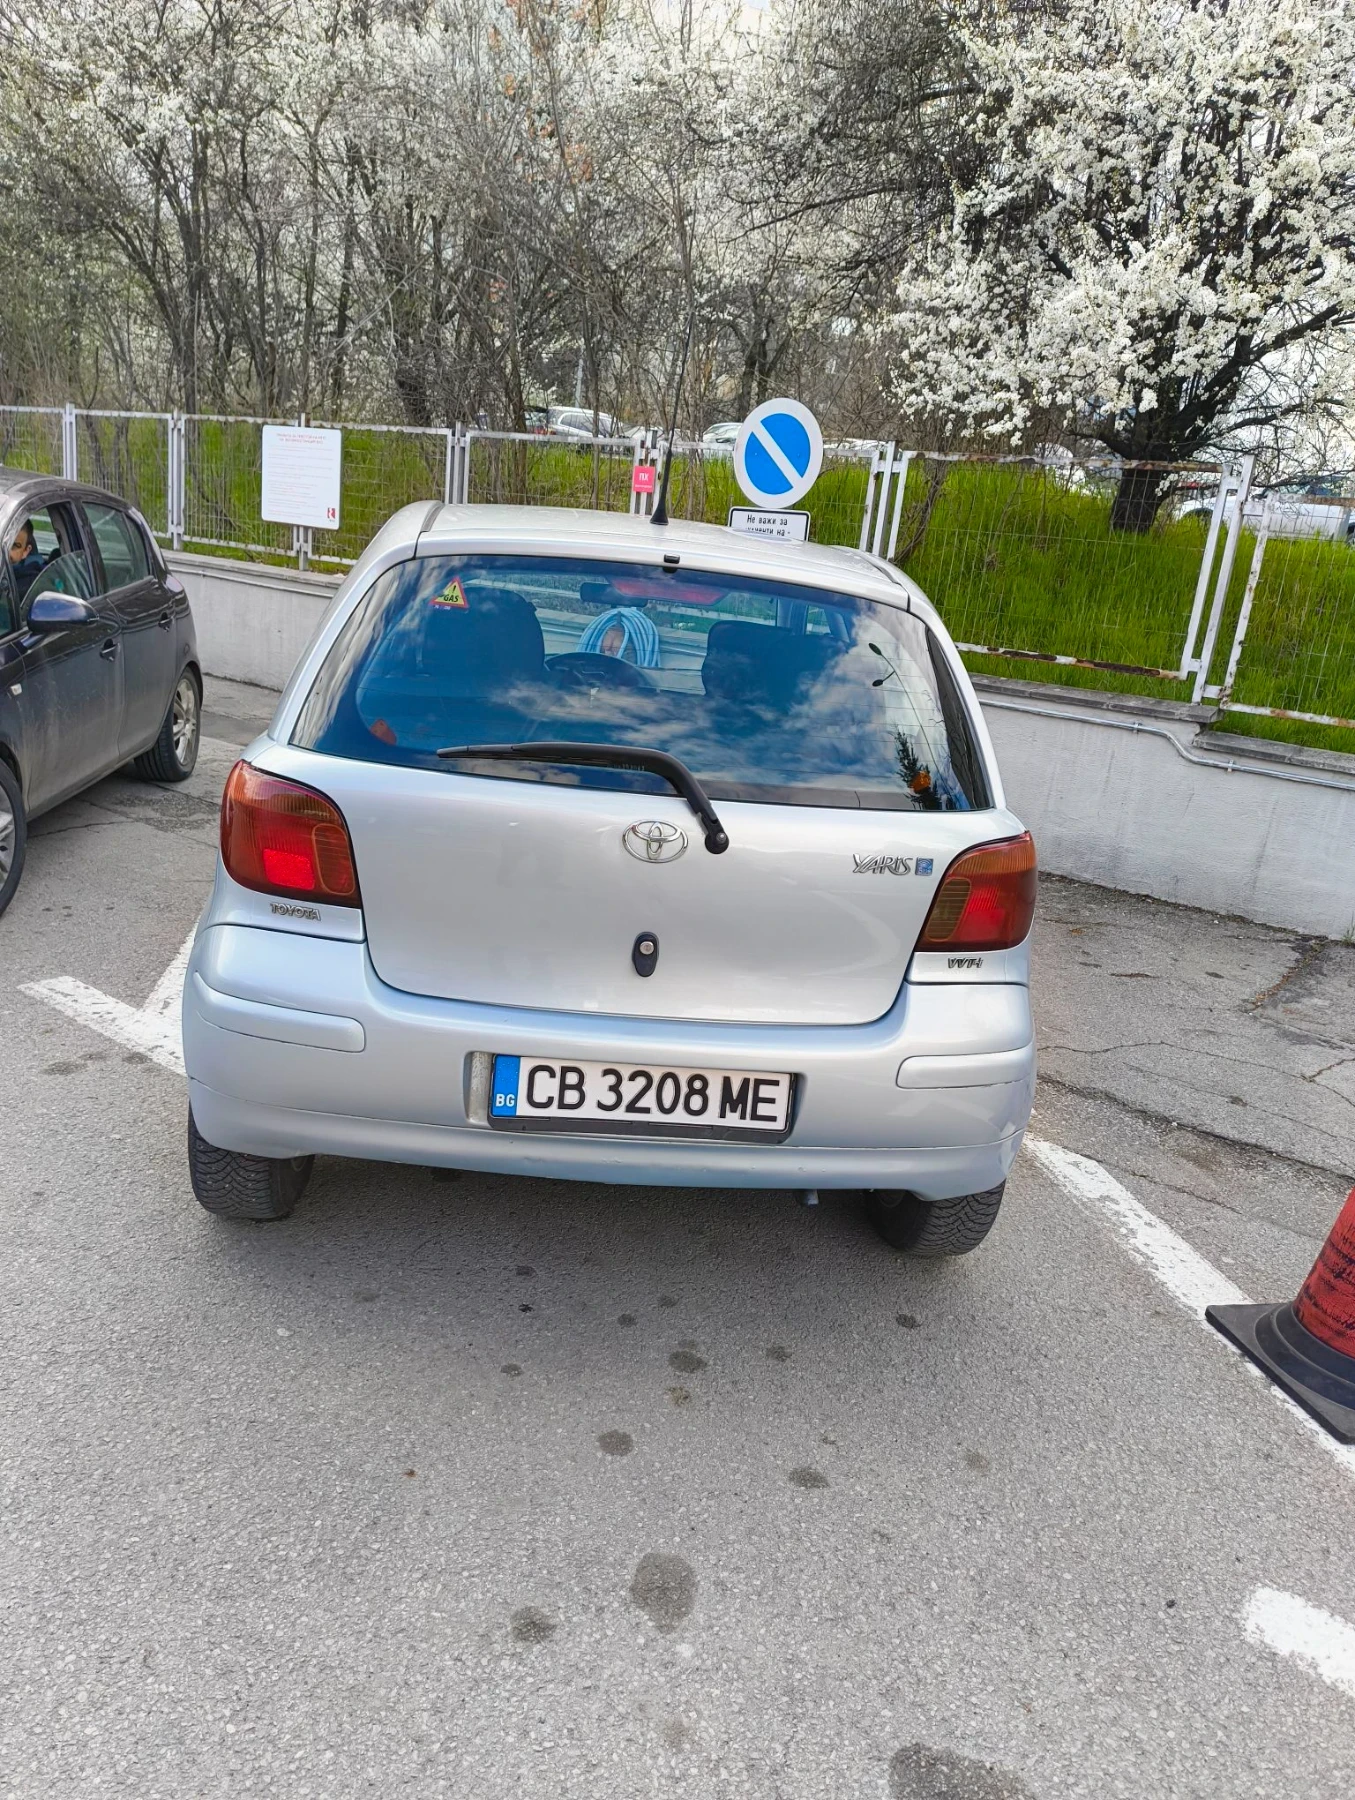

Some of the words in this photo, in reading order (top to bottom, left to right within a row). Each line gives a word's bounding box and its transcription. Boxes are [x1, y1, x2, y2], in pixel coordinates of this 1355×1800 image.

[747, 514, 756, 524] Не
[758, 517, 777, 525] важи
[779, 518, 788, 526] за
[776, 529, 786, 537] на
[443, 594, 459, 602] GAS
[270, 903, 322, 921] TOYOTA
[526, 1064, 586, 1110] CB
[596, 1068, 709, 1117] 3208
[719, 1076, 780, 1122] ME
[495, 1094, 515, 1108] BG
